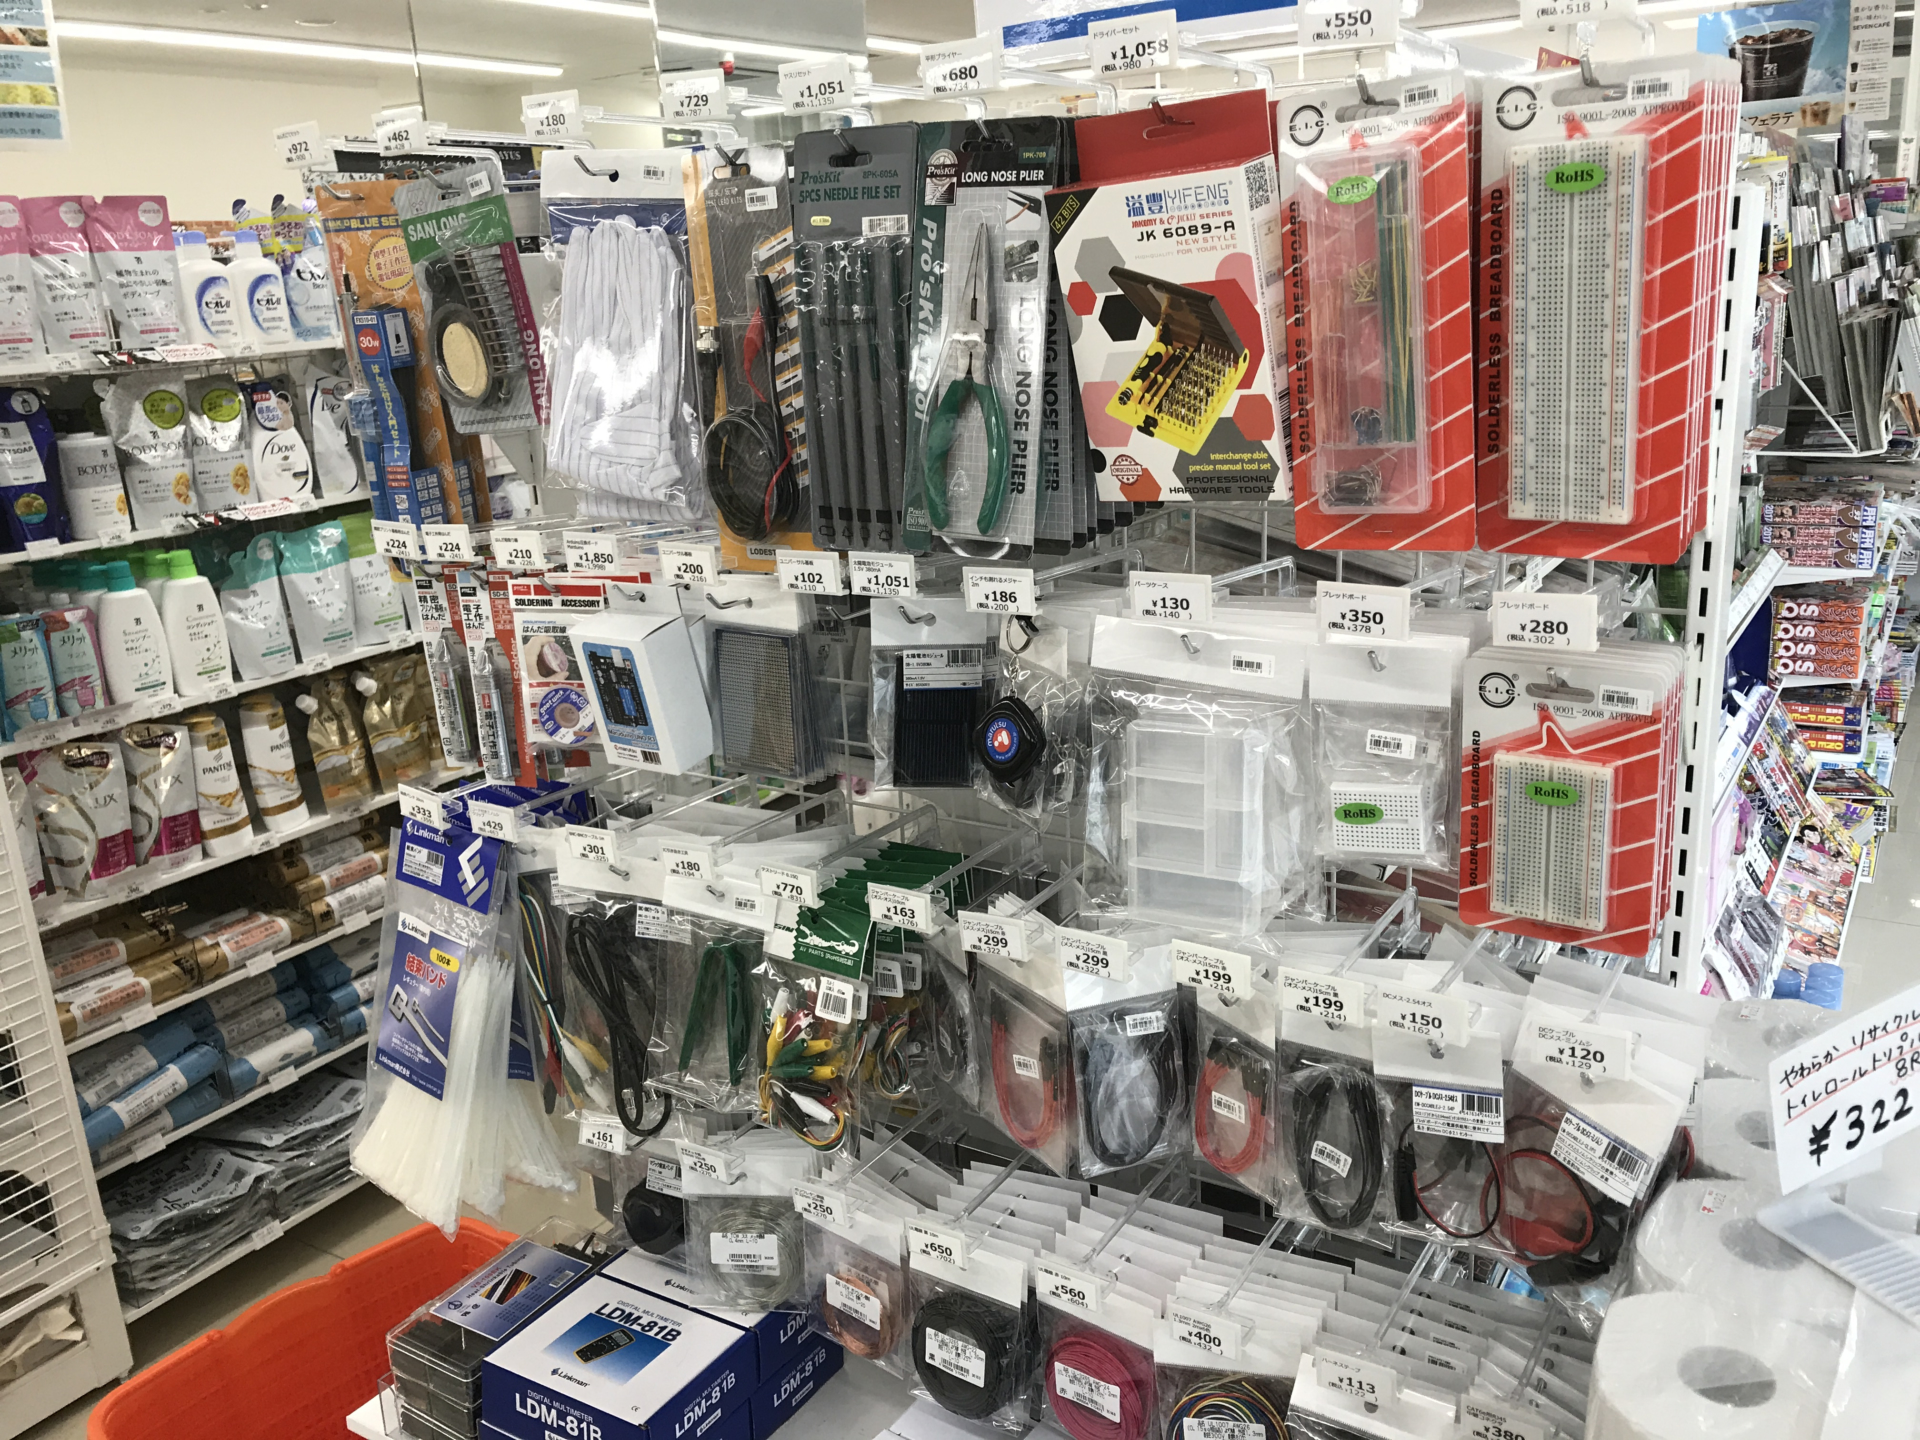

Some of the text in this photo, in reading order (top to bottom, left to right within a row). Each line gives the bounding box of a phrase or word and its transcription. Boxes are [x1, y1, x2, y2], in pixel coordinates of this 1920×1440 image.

[1324, 10, 1372, 28] ¥550
[1110, 38, 1169, 60] ¥1,058
[941, 64, 978, 82] ¥680
[798, 80, 845, 99] ¥1,051
[679, 93, 709, 109] ¥729
[539, 112, 566, 128] ¥180
[1556, 112, 1576, 126] ISO
[386, 129, 411, 143] ¥462
[287, 141, 310, 155] ¥972
[862, 170, 899, 180] 8PK-605A
[961, 168, 1045, 183] LONG NOSE PLIER
[1554, 167, 1595, 185] RoHS
[823, 186, 860, 202] NEEDLE
[862, 185, 884, 200] FILE
[885, 184, 902, 199] SET
[1167, 182, 1229, 205] YIFENG
[1334, 179, 1369, 198] RoHS
[350, 217, 379, 229] BLUE
[1199, 210, 1234, 220] SERIES
[1136, 220, 1237, 242] JK 6089-A
[1176, 233, 1238, 246] NEW STYLE
[1176, 242, 1239, 256] FOR YOUR LIFE
[1486, 187, 1504, 455] SOLDERLESS BREADBOARD
[1295, 332, 1313, 455] SOLDERLESS
[1013, 377, 1033, 433] NOSE
[269, 441, 297, 456] Dove
[1009, 439, 1028, 496] PLIER
[1112, 465, 1142, 475] ORIGINAL
[1188, 462, 1272, 473] precise manual tool set
[1169, 486, 1276, 496] HARDWARE TOOLS
[385, 539, 407, 550] ¥224
[438, 541, 461, 553] ¥224
[508, 548, 533, 560] ¥210
[577, 552, 615, 566] ¥1,850
[676, 562, 704, 575] ¥200
[793, 572, 824, 585] ¥102
[866, 574, 910, 589] ¥1,051
[514, 598, 601, 609] SOLDERING ACCESSORY
[983, 590, 1018, 604] ¥186
[1151, 597, 1191, 611] ¥130
[1321, 591, 1368, 601] ブレッドボード
[461, 604, 483, 614] 電子
[1499, 601, 1550, 612] ブレッドボード
[1339, 609, 1385, 625] ¥350
[464, 621, 486, 630] はんだ
[1519, 619, 1569, 635] ¥280
[59, 633, 87, 647] メリット
[11, 646, 40, 659] メリット
[1532, 703, 1550, 713] ISO
[1608, 711, 1657, 725] APPROVED
[1533, 785, 1570, 800] RoHS
[411, 804, 432, 819] ¥333
[1343, 808, 1376, 819] RoHS
[1469, 730, 1481, 887] SOLDERLESS BREADBOARD
[481, 819, 504, 832] ¥429
[413, 824, 446, 846] Linkman
[582, 845, 606, 856] ¥301
[674, 859, 701, 872] ¥180
[775, 881, 804, 897] ¥770
[885, 904, 916, 920] ¥163
[976, 934, 1010, 949] ¥299
[1075, 952, 1111, 969] ¥299
[404, 951, 448, 990] 結束バンド
[1194, 968, 1233, 985] ¥199
[1303, 994, 1345, 1013] ¥199
[1400, 1010, 1443, 1030] ¥150
[1538, 1025, 1577, 1039] DCケーブル
[1557, 1045, 1606, 1065] ¥120
[1779, 1045, 1840, 1089] やわらか
[1808, 1087, 1914, 1167] ¥322
[591, 1131, 614, 1144] ¥161
[692, 1160, 717, 1174] ¥250
[806, 1201, 834, 1216] ¥250
[923, 1241, 954, 1258] ¥650
[1053, 1283, 1087, 1301] ¥560
[617, 1299, 683, 1328] DIGITAL MULTIMETER
[594, 1302, 682, 1343] LDM-81B
[1186, 1329, 1222, 1348] ¥400
[558, 1369, 591, 1388] Linkman
[773, 1348, 827, 1409] LDM-81B
[1336, 1375, 1376, 1395] ¥113
[527, 1389, 594, 1424] DIGITAL MULTIMETER
[674, 1371, 737, 1439] LDM-81B
[514, 1392, 602, 1440] LDM-81B
